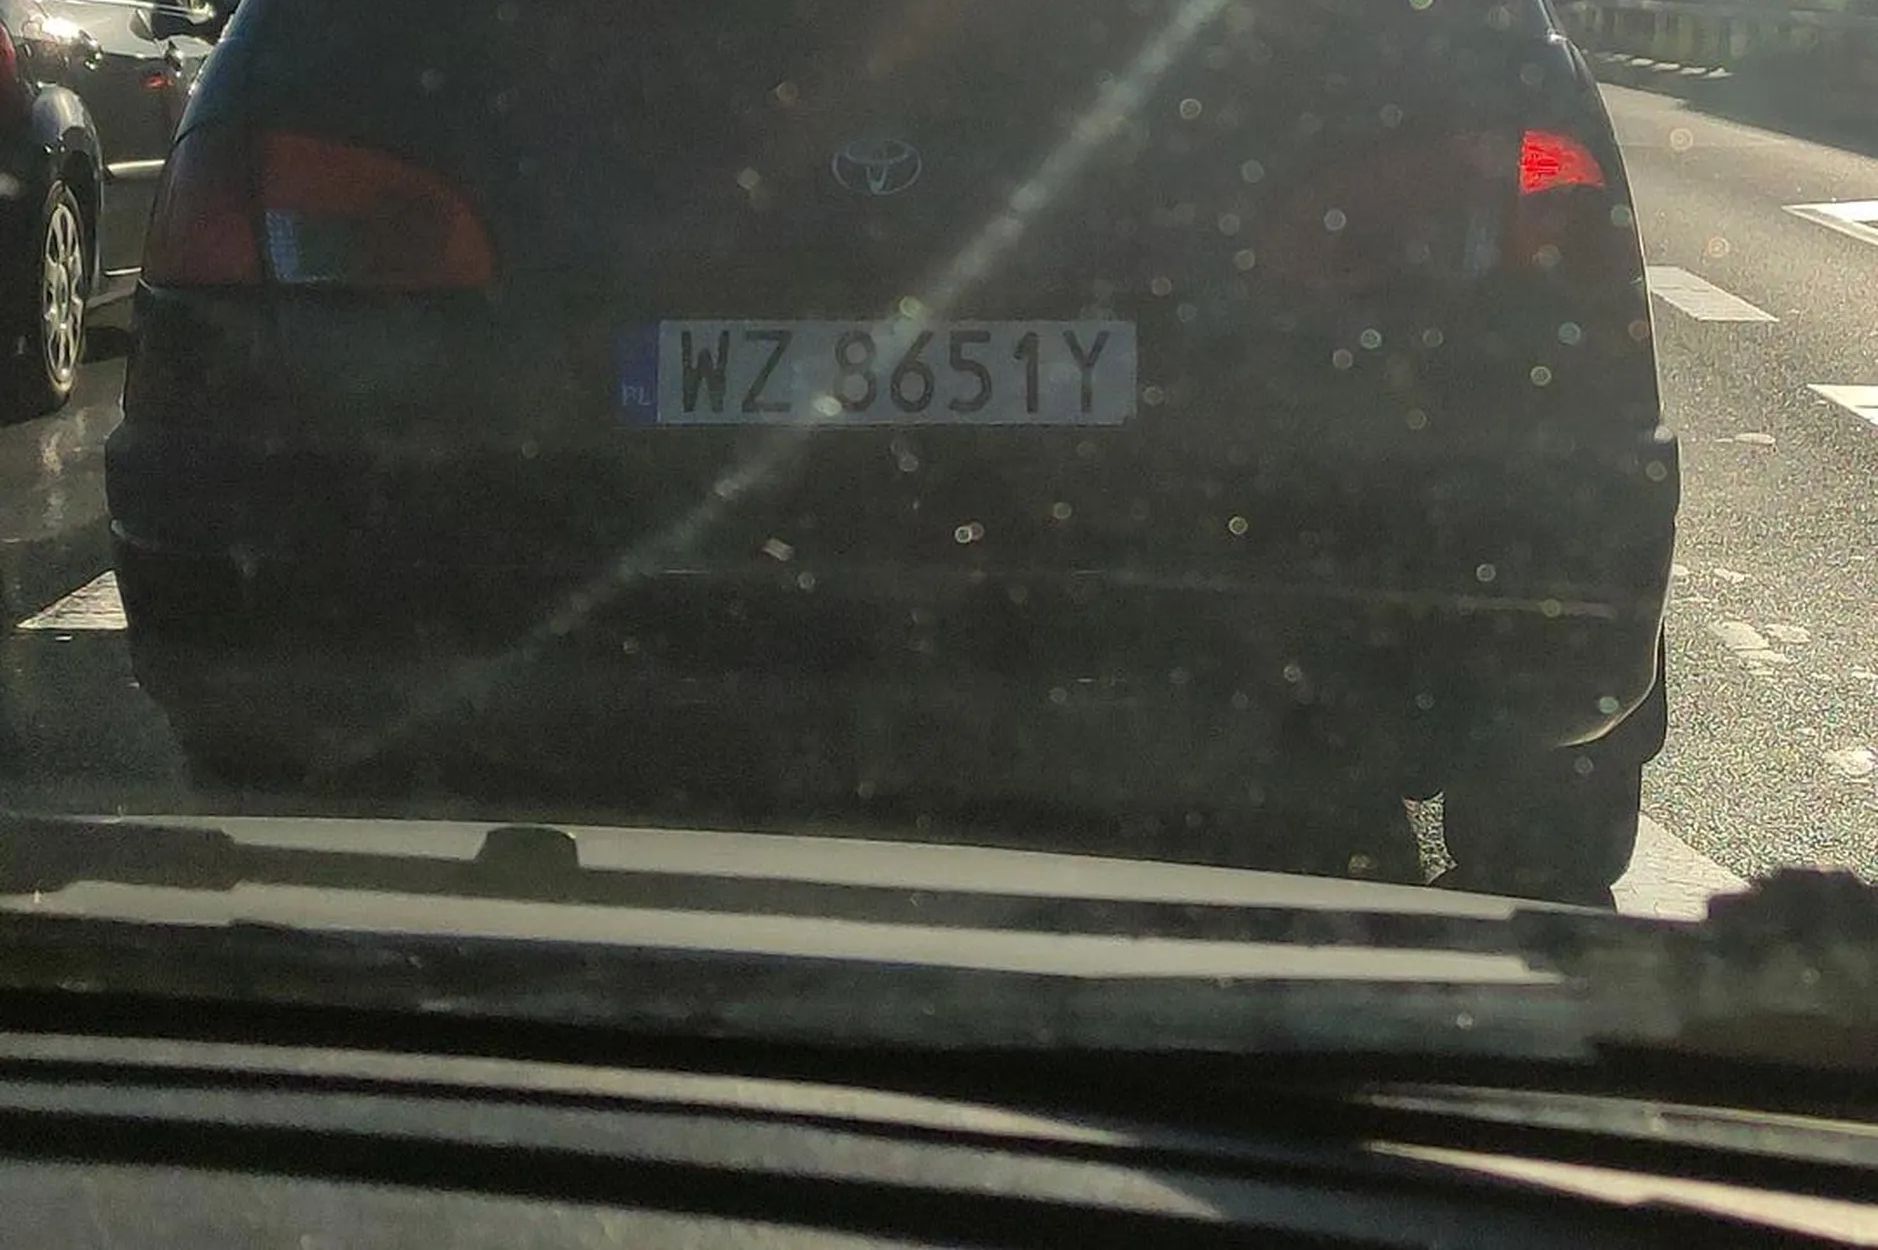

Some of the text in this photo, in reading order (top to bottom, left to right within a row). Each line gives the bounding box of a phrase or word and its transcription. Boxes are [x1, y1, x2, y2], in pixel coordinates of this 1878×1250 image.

[621, 387, 651, 408] PL
[680, 329, 1111, 414] WZ 8651Y
